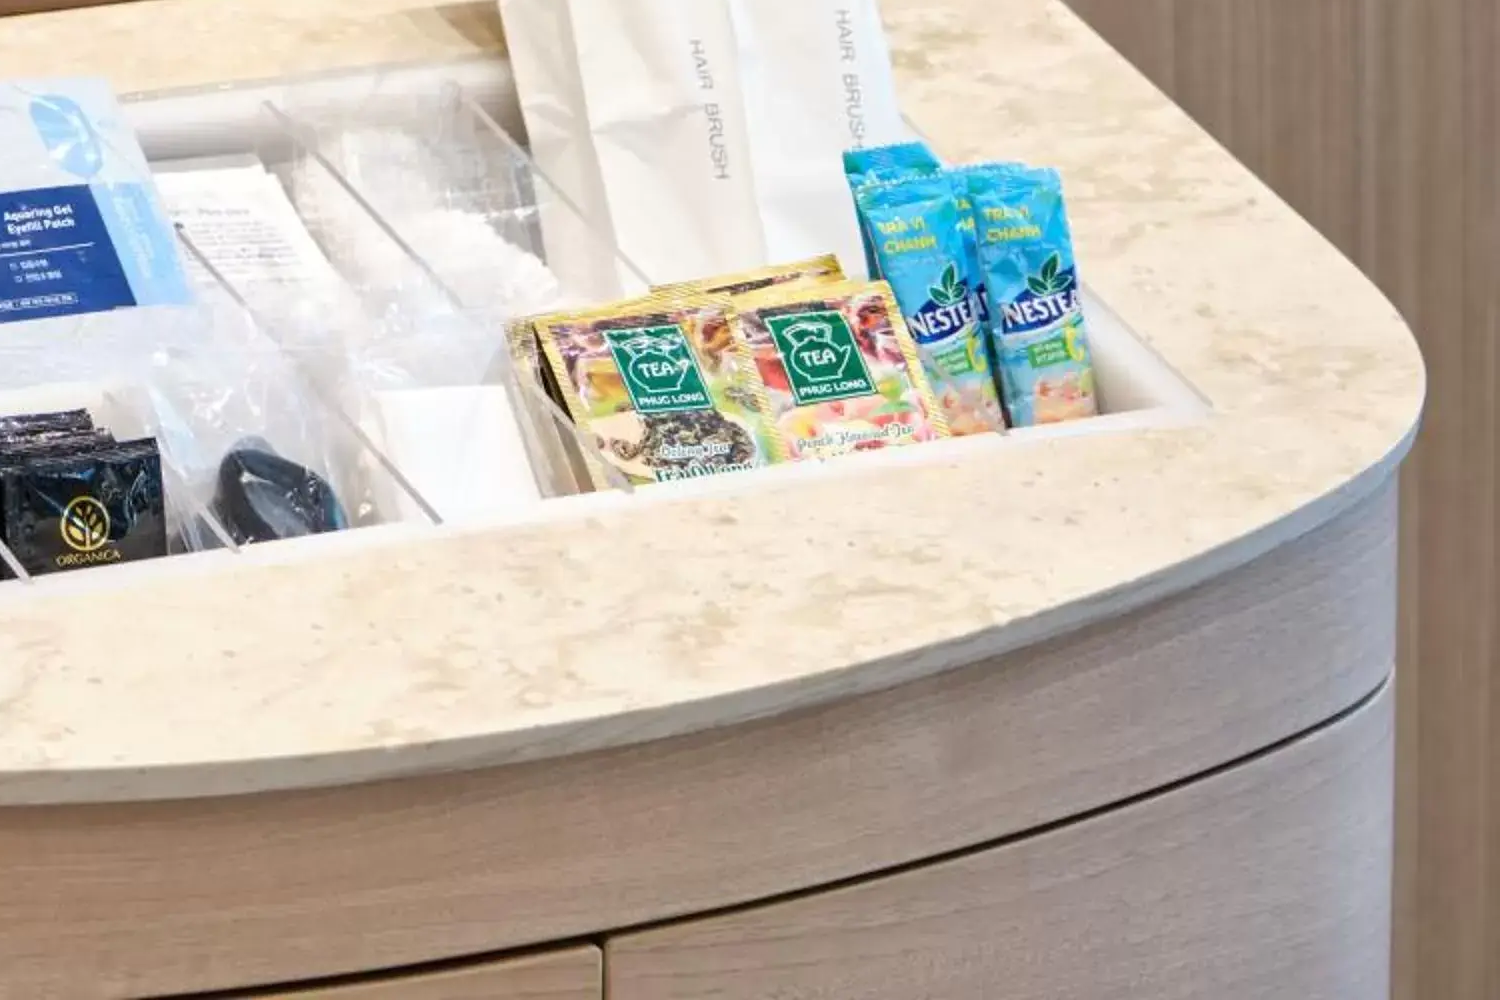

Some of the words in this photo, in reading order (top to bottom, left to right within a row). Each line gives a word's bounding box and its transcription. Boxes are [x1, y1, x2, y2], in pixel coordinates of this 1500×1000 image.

[834, 9, 857, 63] HAIR
[688, 38, 715, 91] HAIR
[704, 102, 732, 181] BRUSH
[842, 72, 866, 150] BRUSH
[3, 207, 54, 222] Aquaring
[53, 203, 74, 216] Gel
[43, 217, 76, 230] Patch
[799, 348, 838, 367] TEA
[637, 361, 675, 378] TEA
[834, 378, 867, 391] LONG
[672, 391, 705, 404] LONG
[55, 548, 122, 567] ORGANICA
